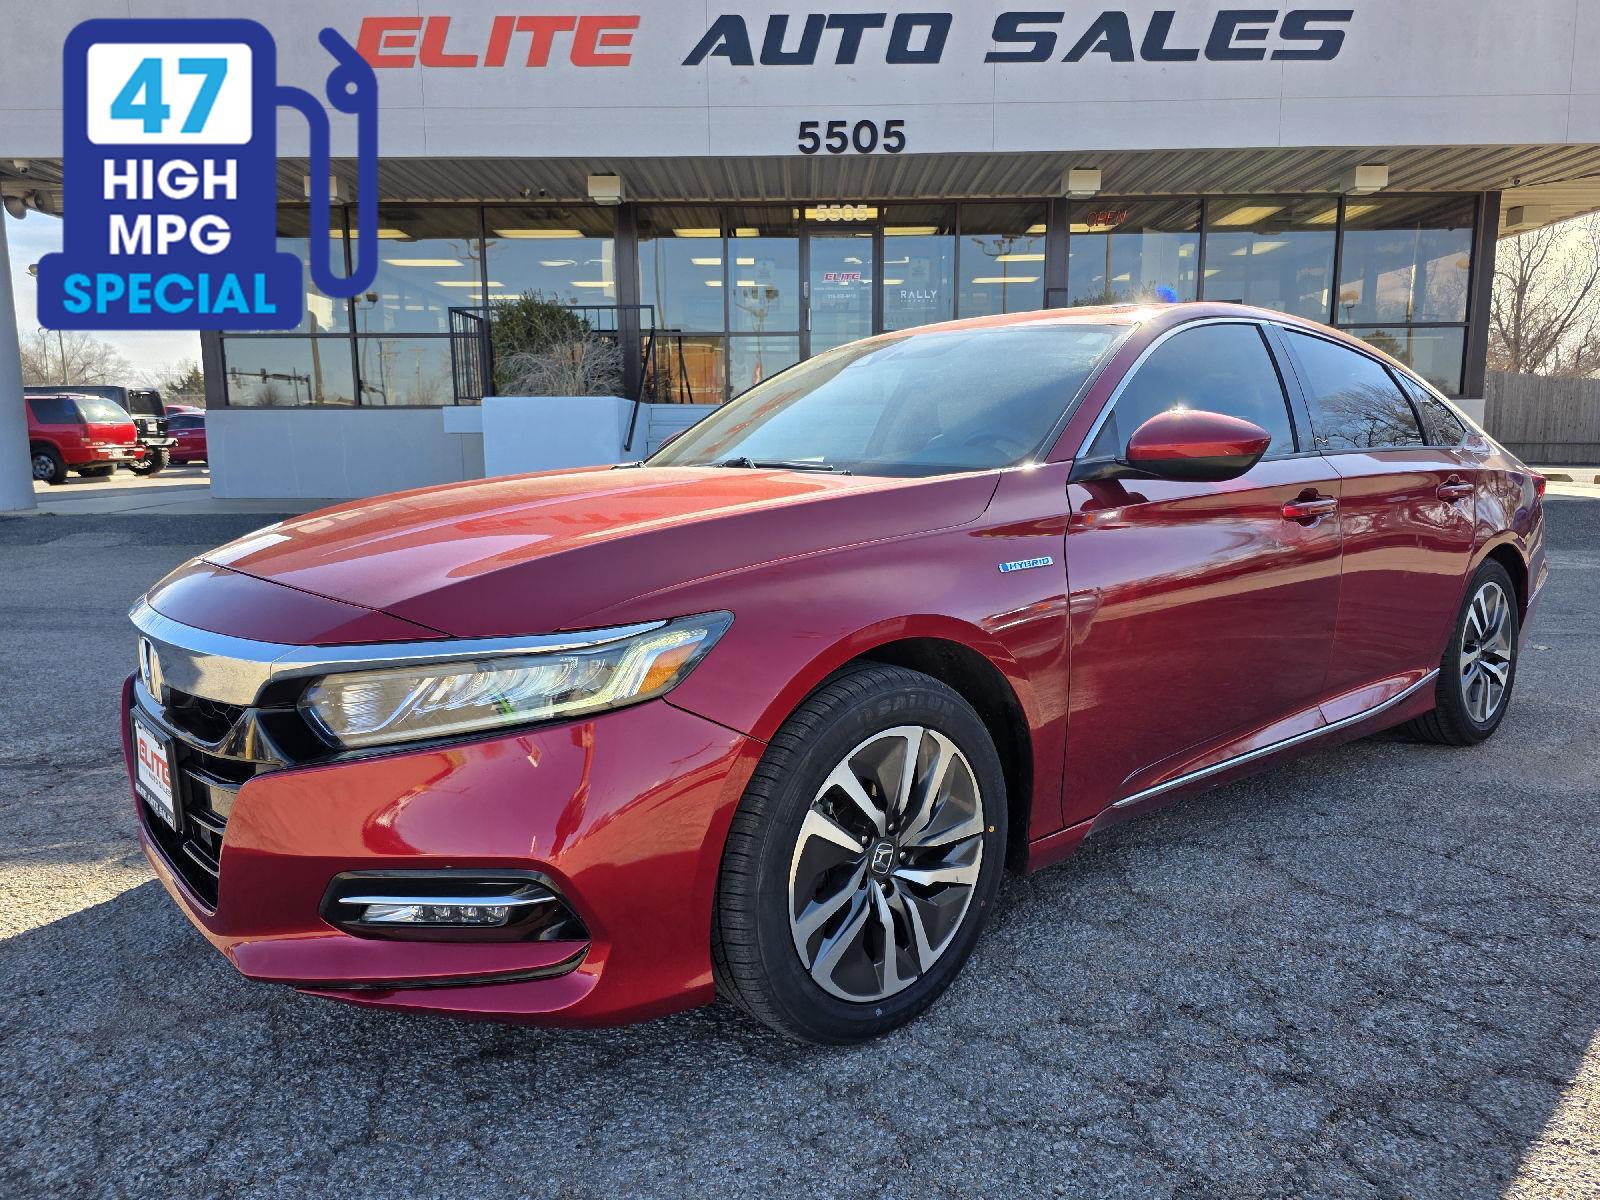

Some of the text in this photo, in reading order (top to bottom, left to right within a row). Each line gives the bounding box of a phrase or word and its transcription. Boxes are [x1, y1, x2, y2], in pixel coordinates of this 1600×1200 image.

[357, 9, 1354, 68] ELITE AUTO SALES
[798, 119, 907, 155] 5505
[815, 204, 868, 222] 5505
[1087, 209, 1128, 227] OPEN
[824, 272, 861, 281] ELITE
[900, 290, 938, 299] RALLY
[1009, 557, 1050, 570] HYBRID
[138, 737, 172, 788] ELITE
